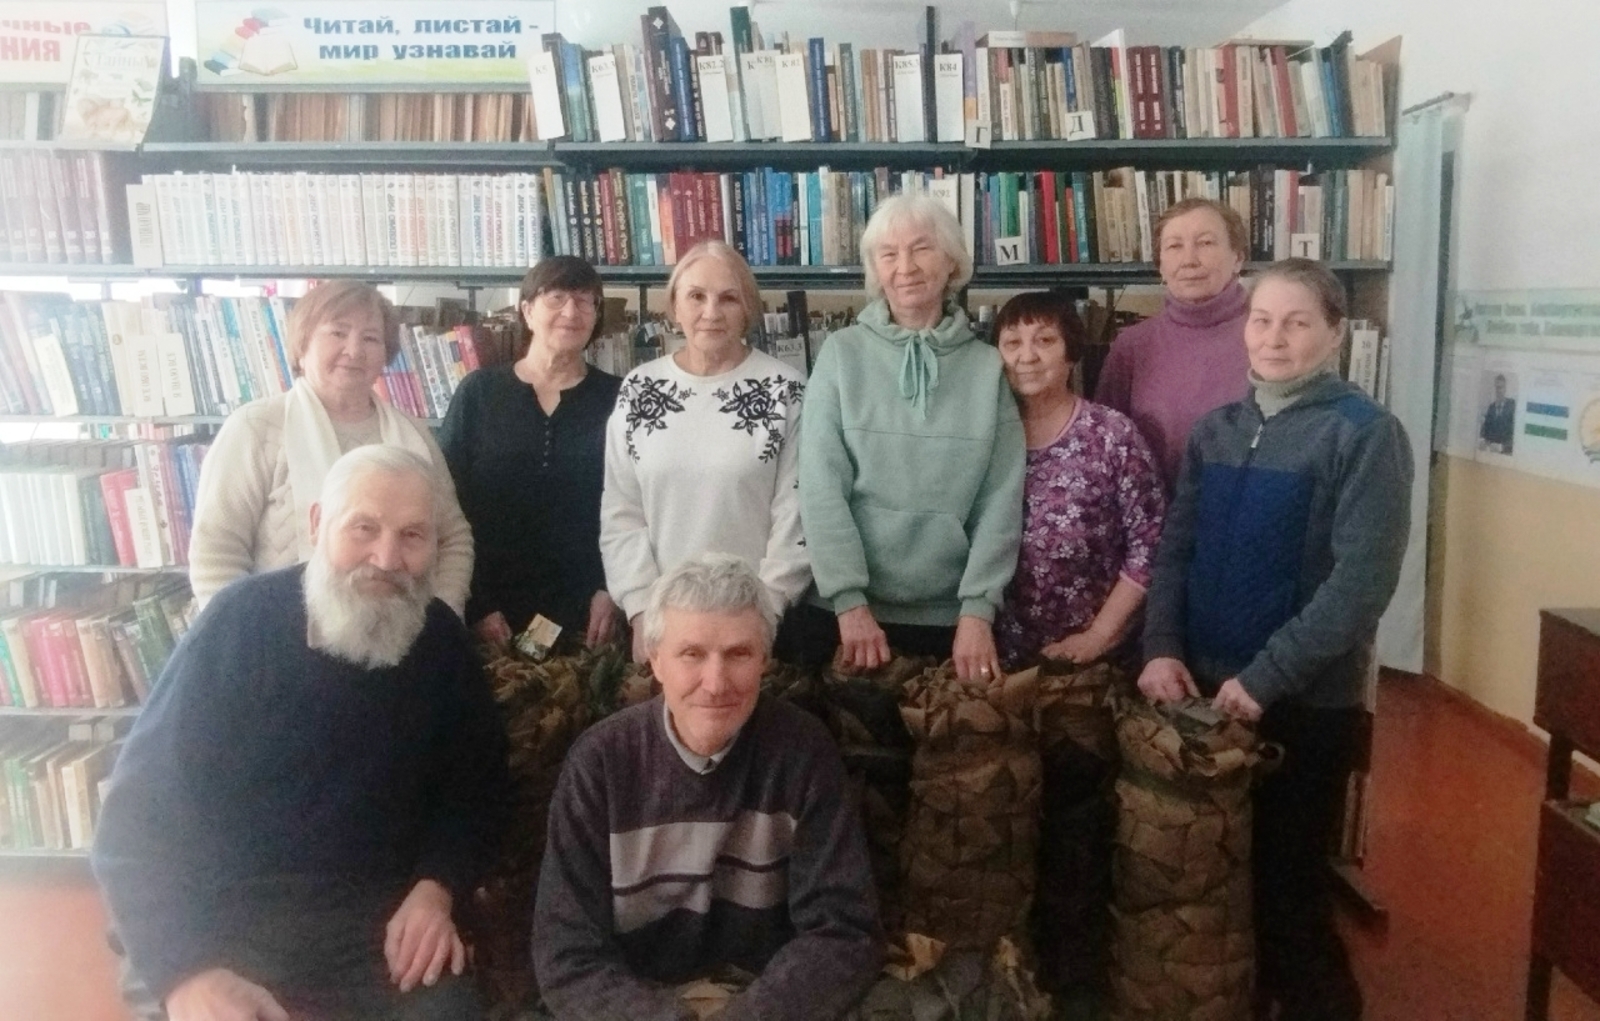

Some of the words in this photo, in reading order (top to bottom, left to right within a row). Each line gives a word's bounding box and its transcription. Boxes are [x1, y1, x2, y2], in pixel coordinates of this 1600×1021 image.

[303, 15, 400, 35] Читай,
[413, 15, 522, 34] листай
[319, 44, 379, 60] мир
[392, 41, 516, 60] узнавай
[975, 125, 988, 144] Г
[1069, 115, 1084, 137] Д
[1000, 244, 1020, 262] М
[1298, 240, 1313, 257] Т
